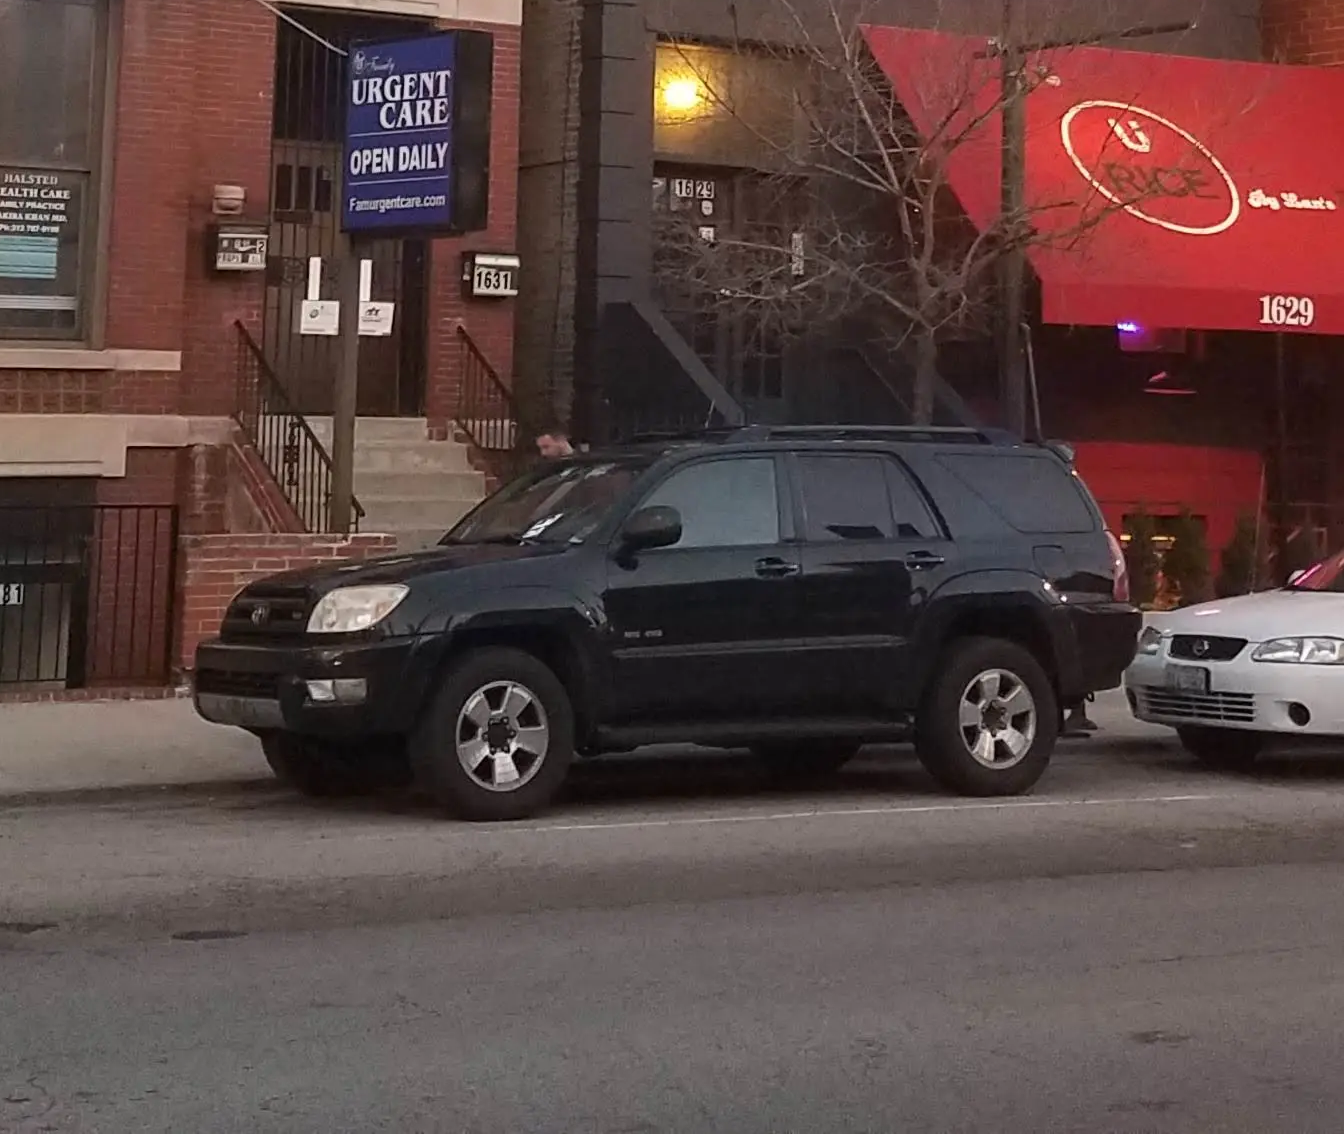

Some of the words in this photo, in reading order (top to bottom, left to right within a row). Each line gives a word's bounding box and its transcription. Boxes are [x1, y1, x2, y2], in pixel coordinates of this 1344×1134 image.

[352, 70, 451, 105] URGENT
[379, 98, 450, 129] CARE
[350, 147, 394, 175] OPEN
[398, 142, 448, 171] DAILY
[3, 173, 58, 185] HALSTED
[677, 180, 714, 198] 1629
[39, 188, 71, 200] CARE
[349, 195, 446, 213] Famurgentcare.com
[25, 200, 65, 210] PRACTICE
[475, 269, 510, 291] 1631
[1259, 294, 1314, 327] 1629
